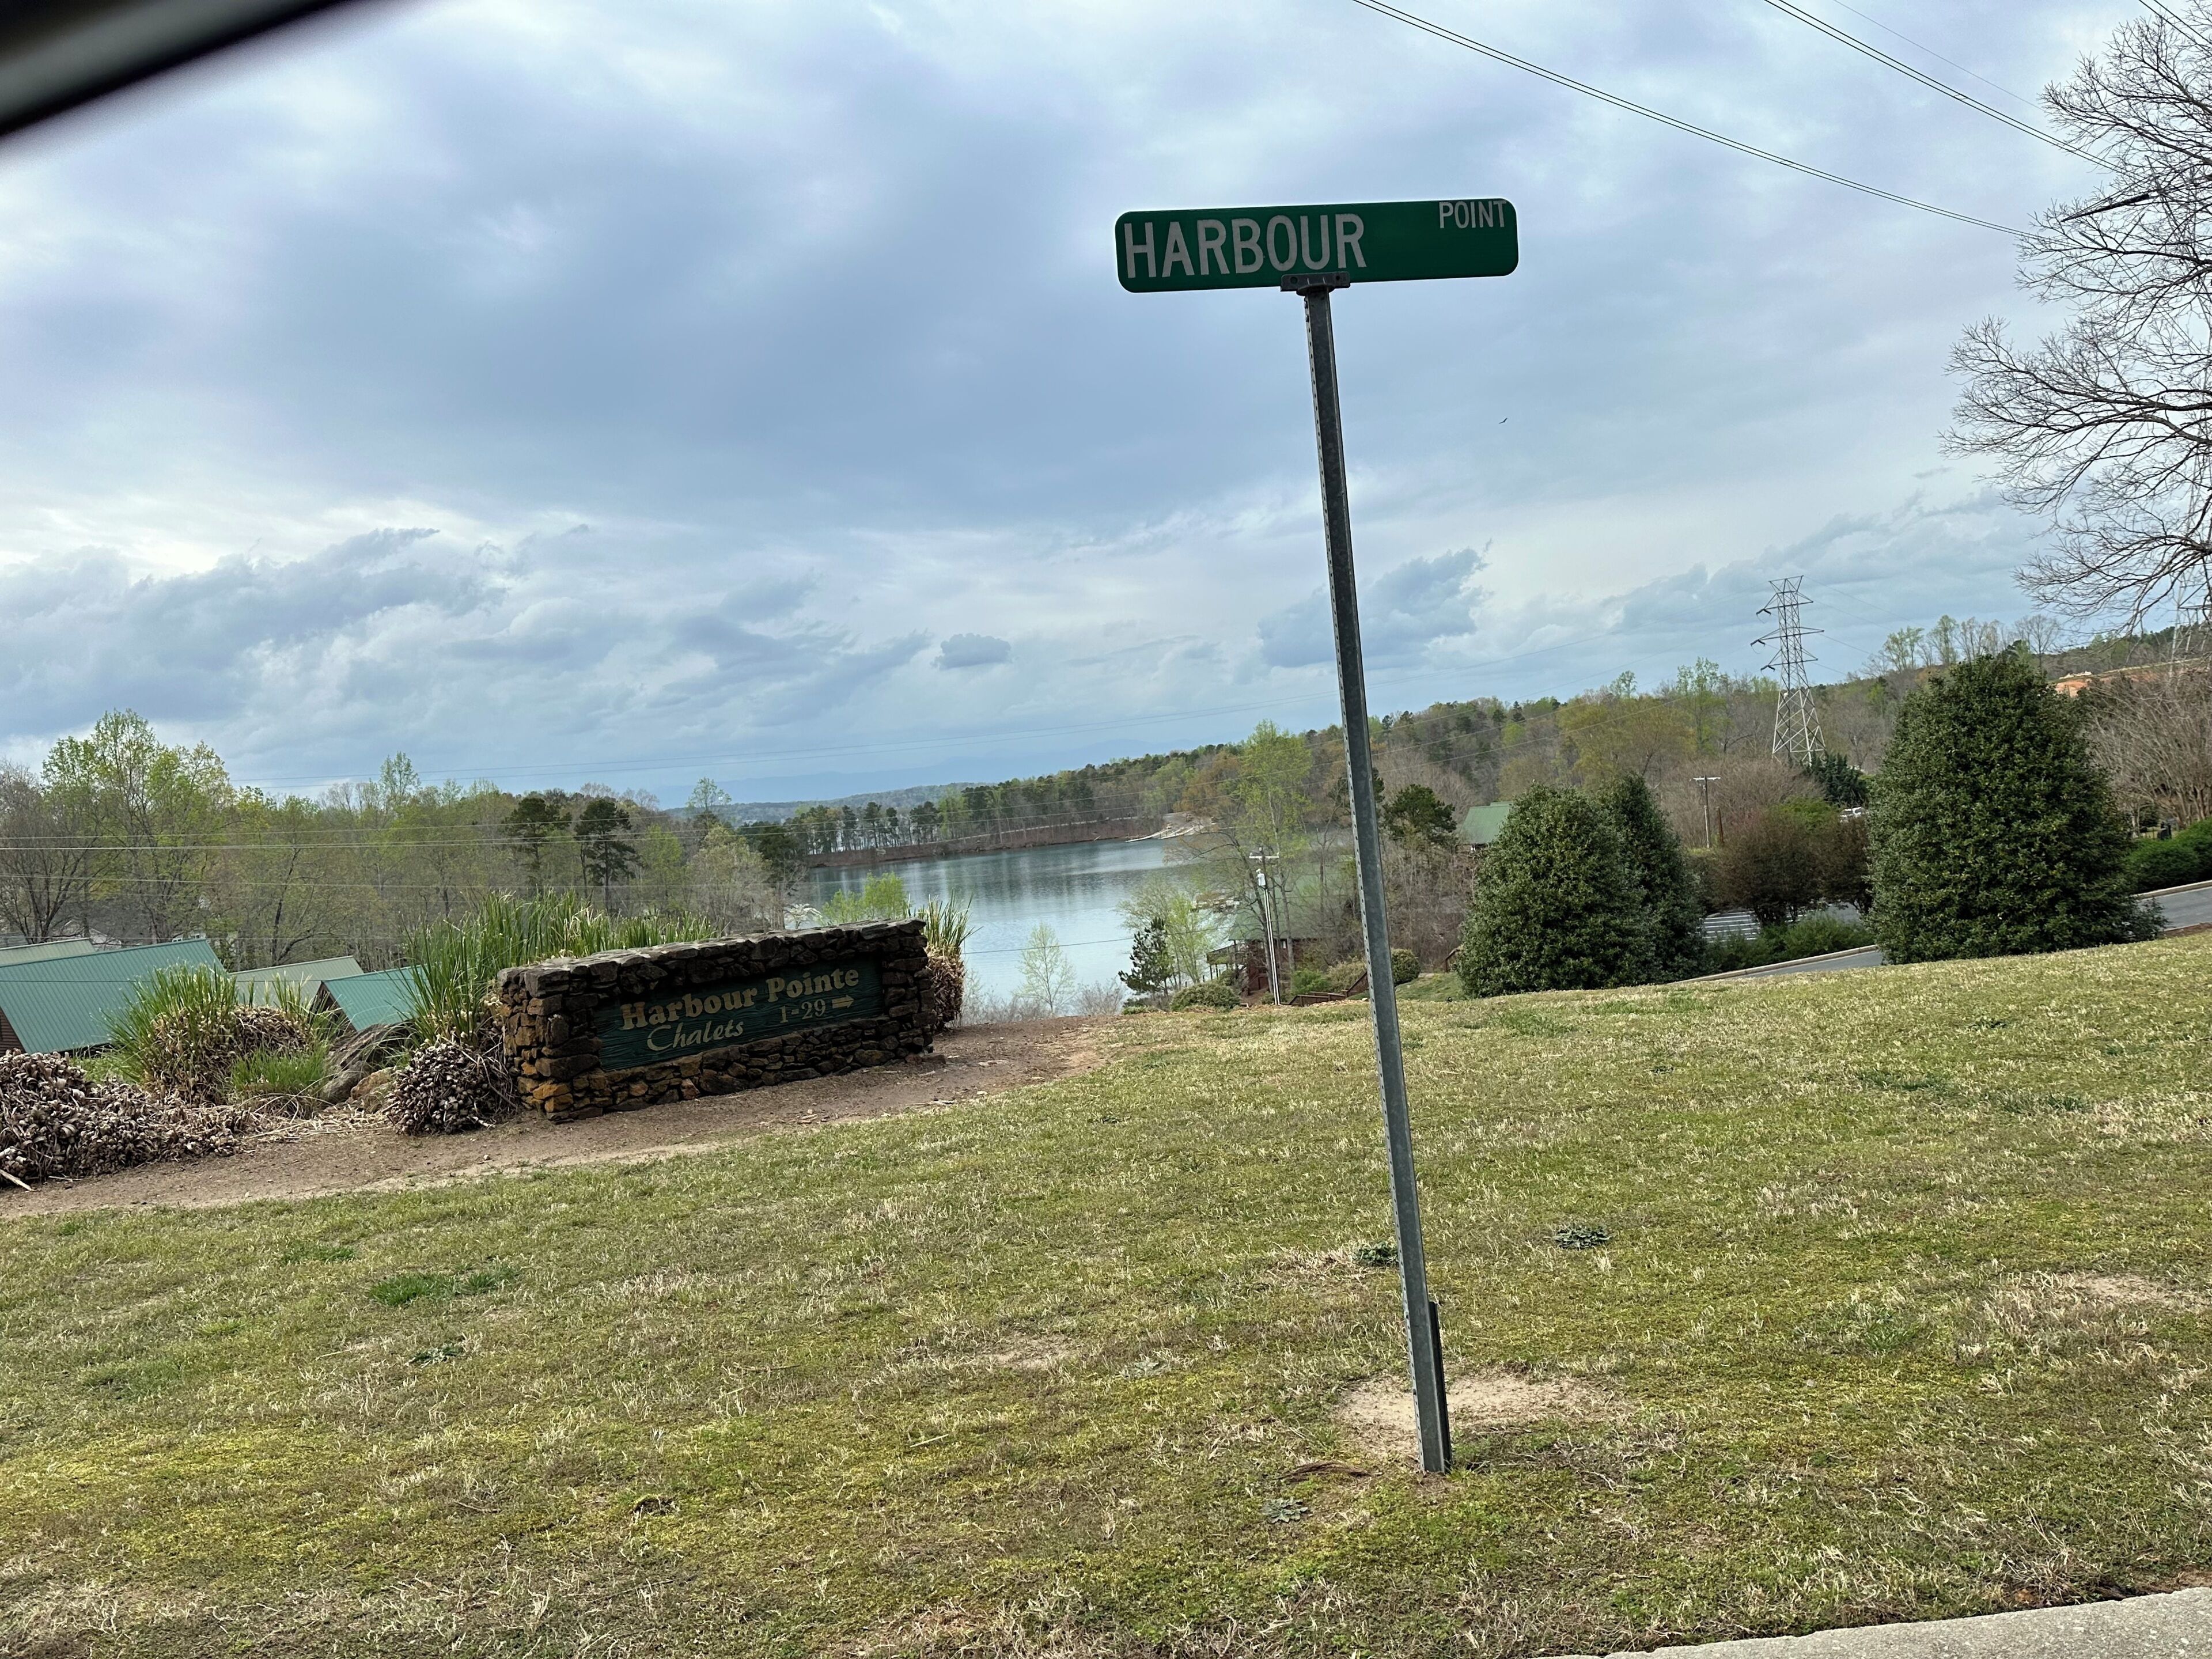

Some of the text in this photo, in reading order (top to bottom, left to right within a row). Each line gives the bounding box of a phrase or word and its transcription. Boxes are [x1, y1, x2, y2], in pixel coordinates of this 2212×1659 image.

[1124, 199, 1507, 278] HARBOUR POINT
[620, 968, 859, 1030] Harbour Pointe
[780, 998, 826, 1024] 1-29
[647, 1019, 744, 1051] Chalets
